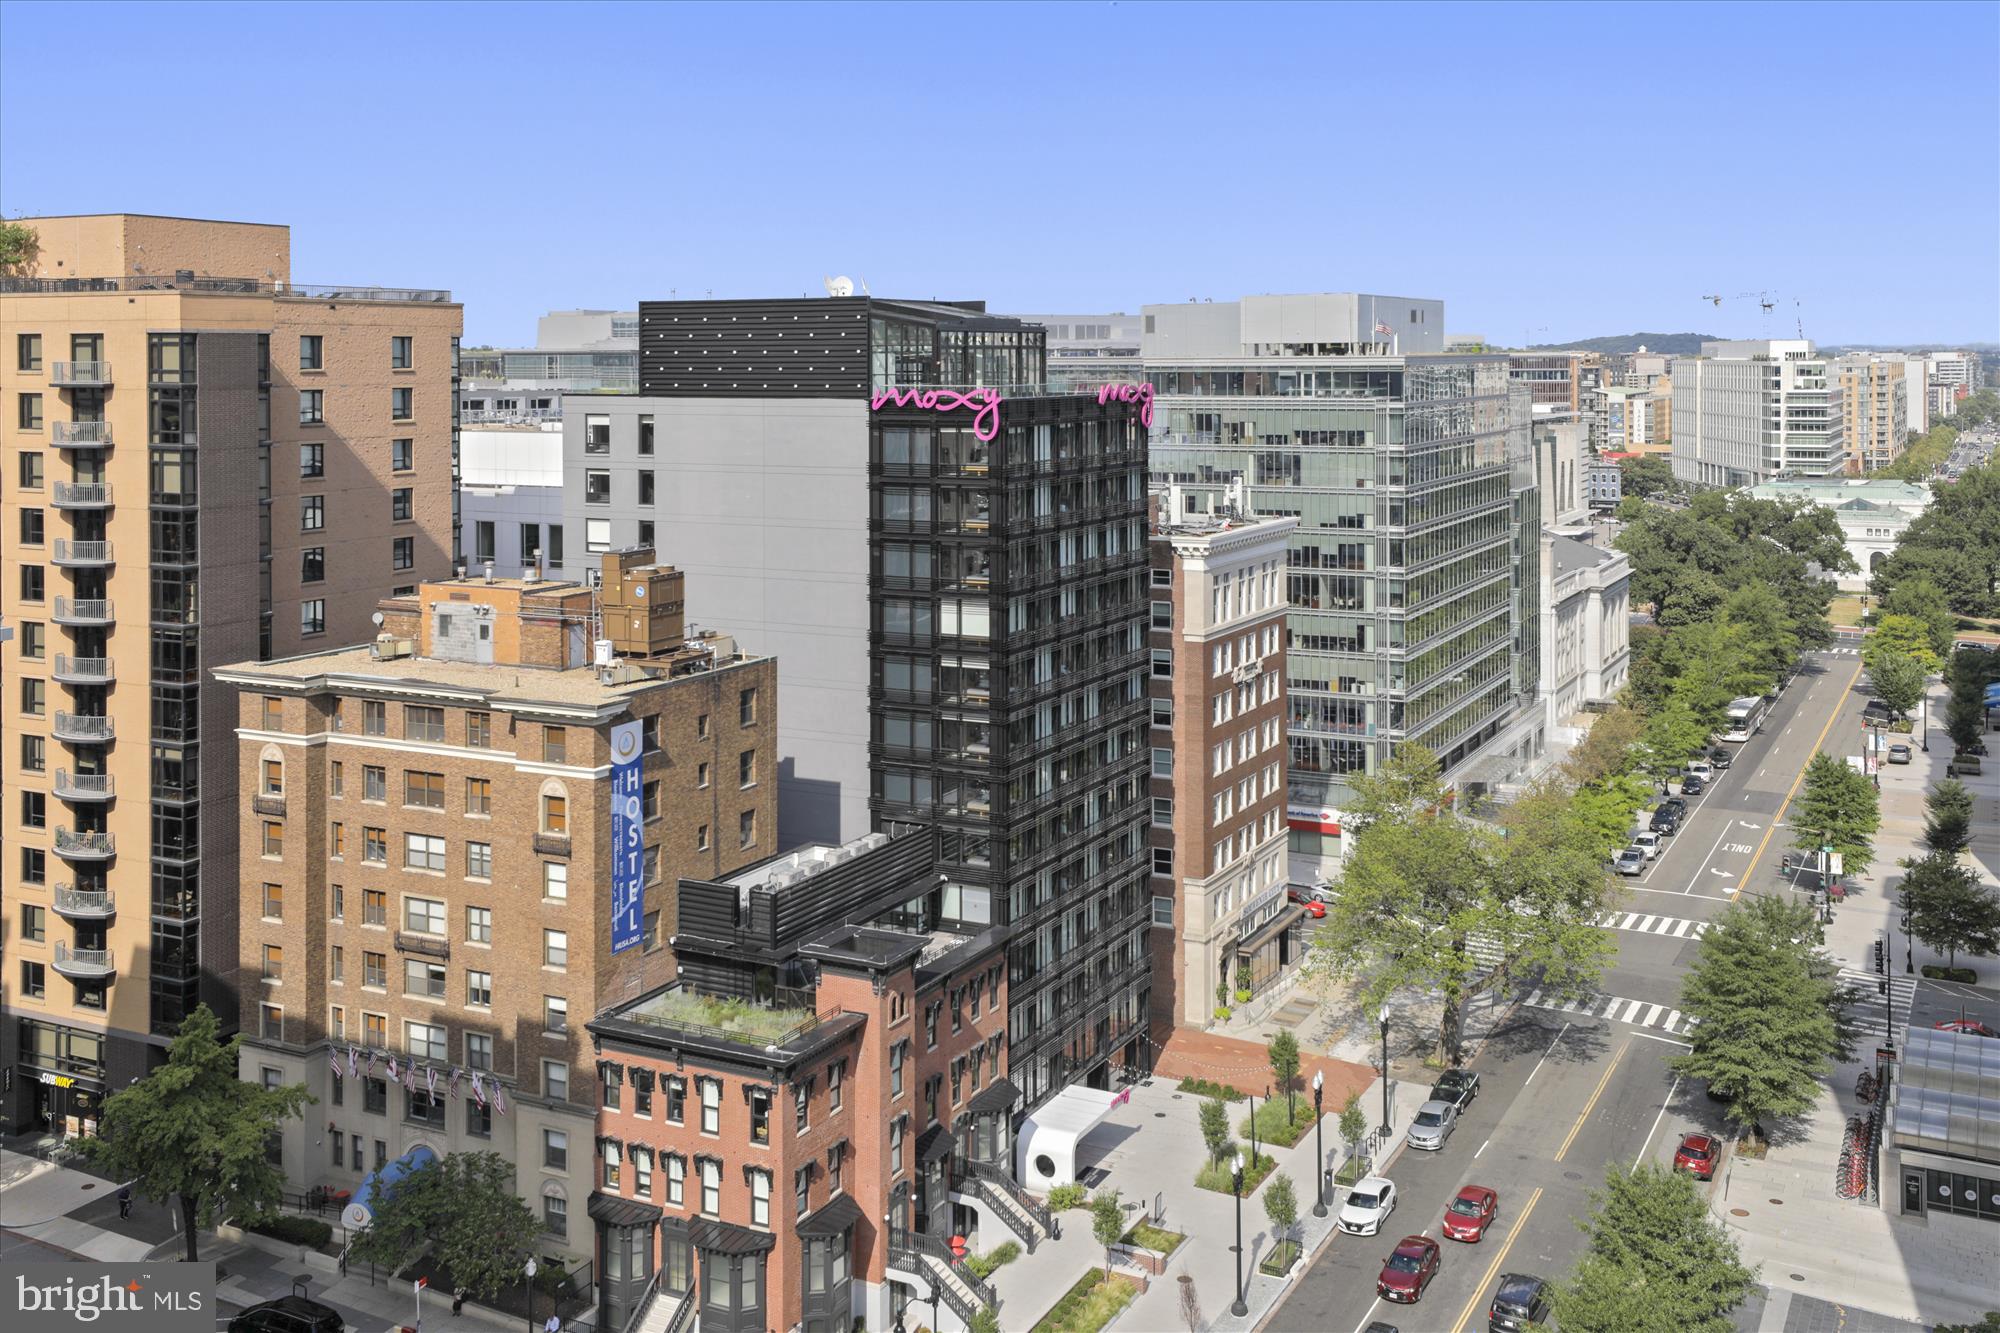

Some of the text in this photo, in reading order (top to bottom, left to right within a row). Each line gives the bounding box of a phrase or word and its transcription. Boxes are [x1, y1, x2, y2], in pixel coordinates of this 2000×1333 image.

[872, 387, 1001, 441] moxy
[626, 767, 640, 931] HOSTEL
[1722, 843, 1752, 854] ONLY
[40, 1072, 75, 1089] SUBWAY
